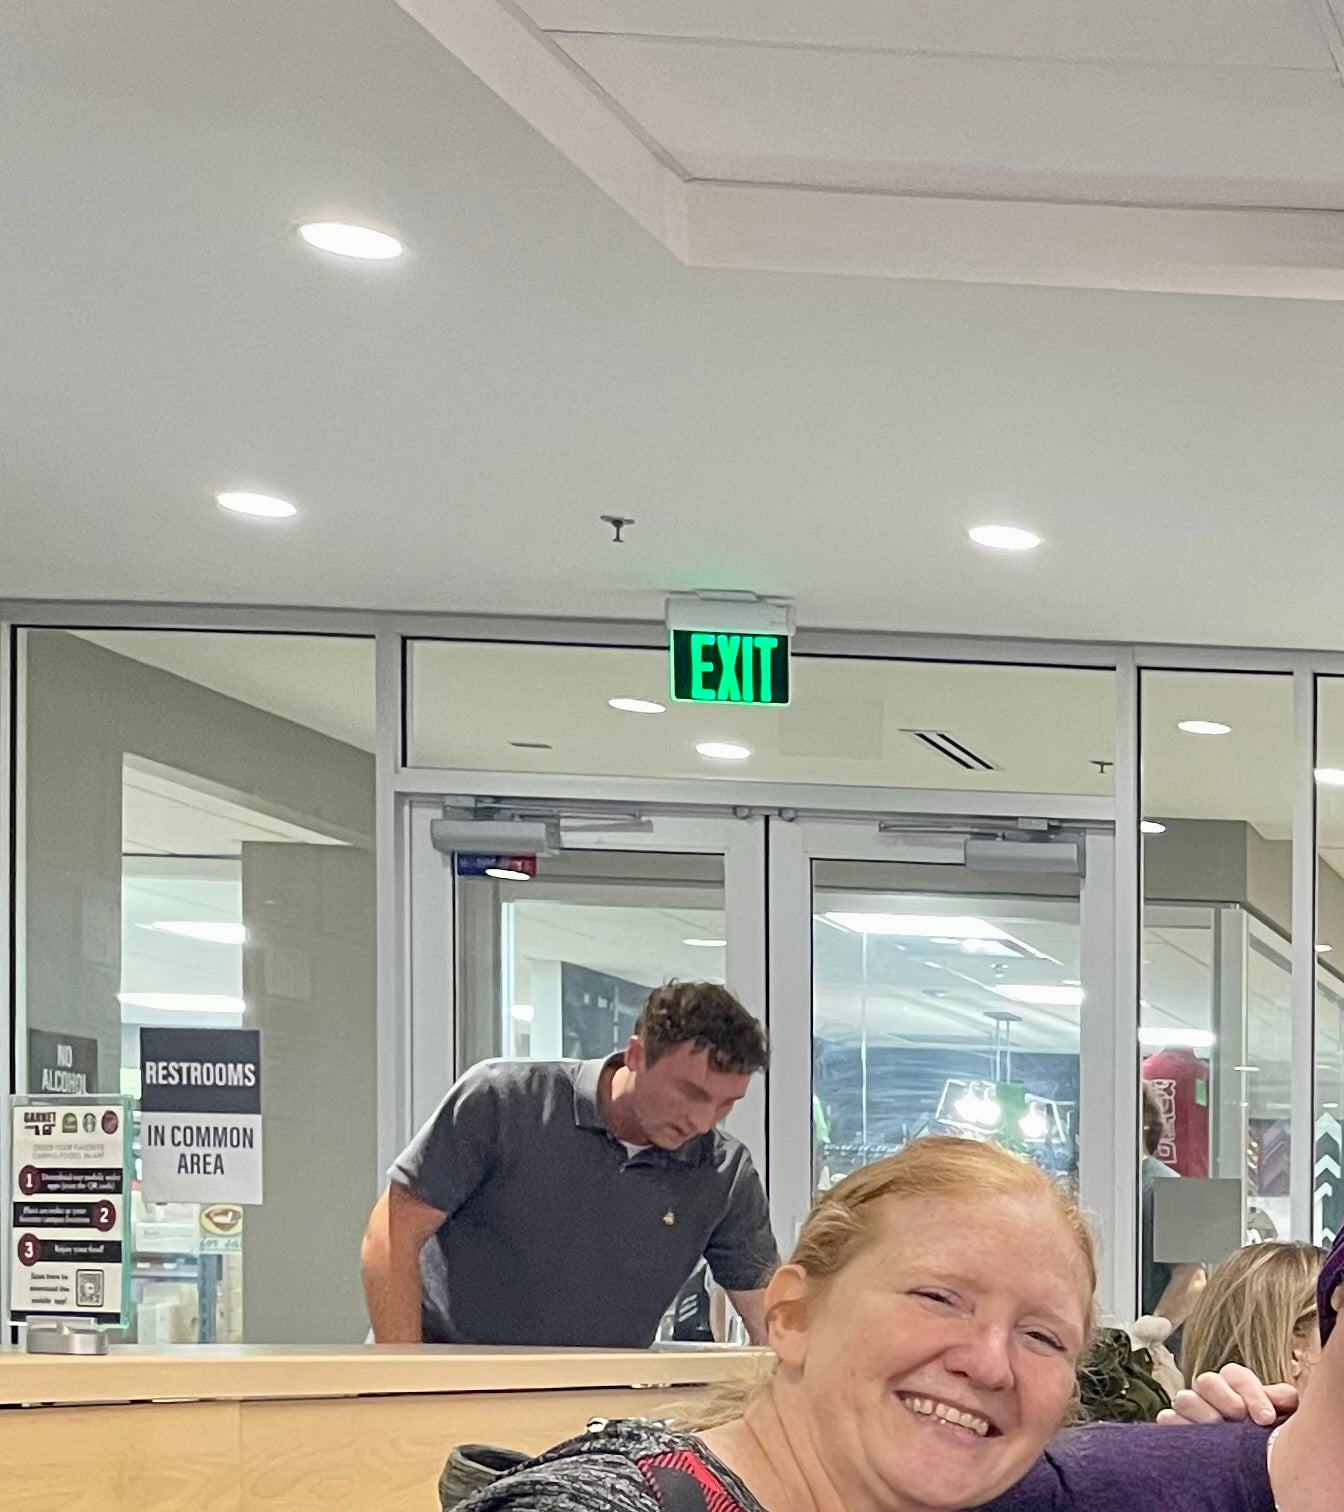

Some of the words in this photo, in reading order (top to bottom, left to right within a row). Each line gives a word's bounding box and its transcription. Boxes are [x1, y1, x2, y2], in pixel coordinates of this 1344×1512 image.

[690, 632, 779, 704] EXIT
[57, 1043, 73, 1069] NO
[42, 1067, 88, 1095] ALCOHOL
[145, 1061, 256, 1087] RESTROOMS
[148, 1124, 165, 1147] IN
[171, 1125, 254, 1149] COMMON
[177, 1152, 225, 1175] AREA
[26, 1172, 33, 1188] 1
[99, 1207, 109, 1223] 2
[24, 1241, 34, 1258] 3
